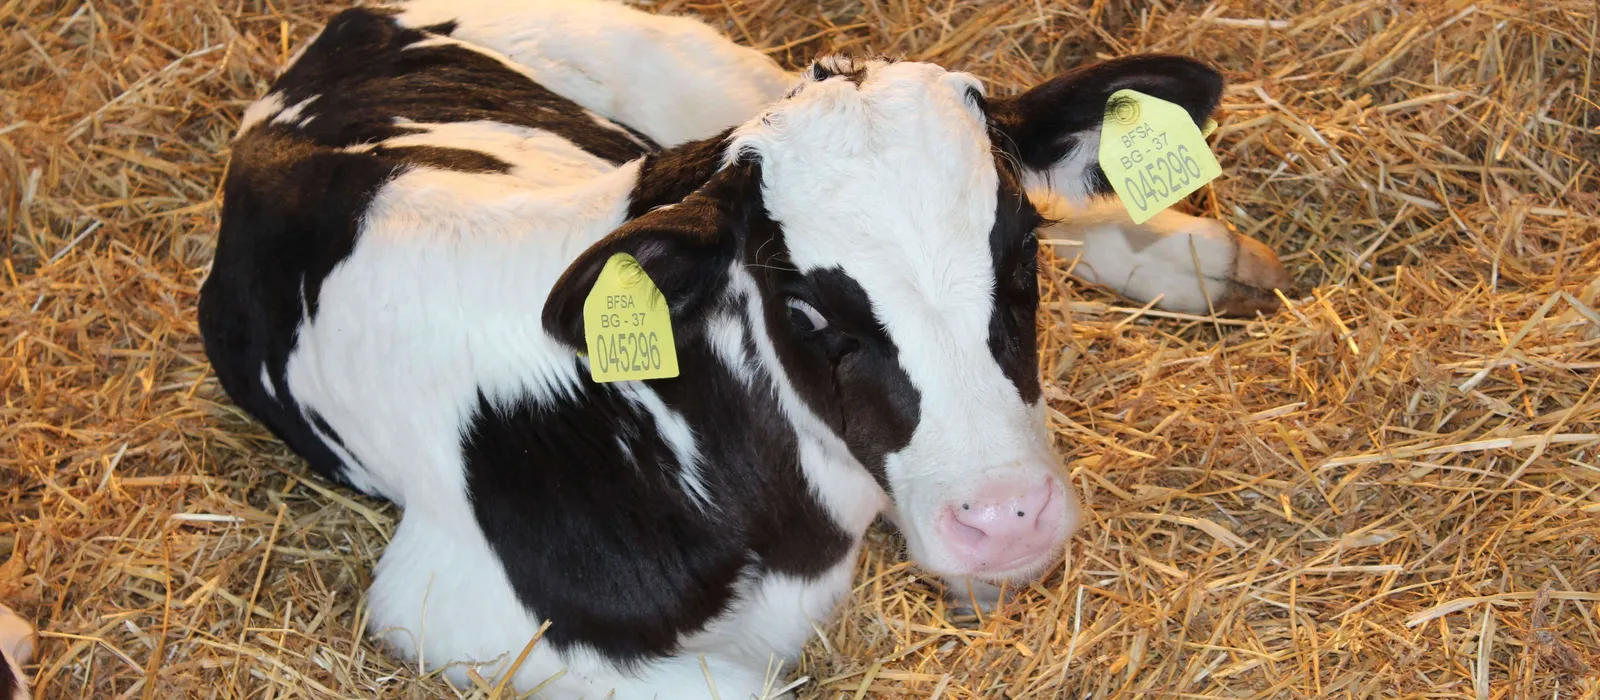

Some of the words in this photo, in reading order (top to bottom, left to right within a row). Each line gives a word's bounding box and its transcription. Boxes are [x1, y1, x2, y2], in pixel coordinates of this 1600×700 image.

[1120, 150, 1144, 170] BG
[1152, 132, 1169, 150] 37
[1121, 122, 1154, 148] BFSA
[1124, 144, 1201, 211] 045296
[607, 295, 635, 309] BFSA
[601, 314, 620, 328] BG
[632, 313, 646, 326] 37
[597, 332, 661, 373] 045296
